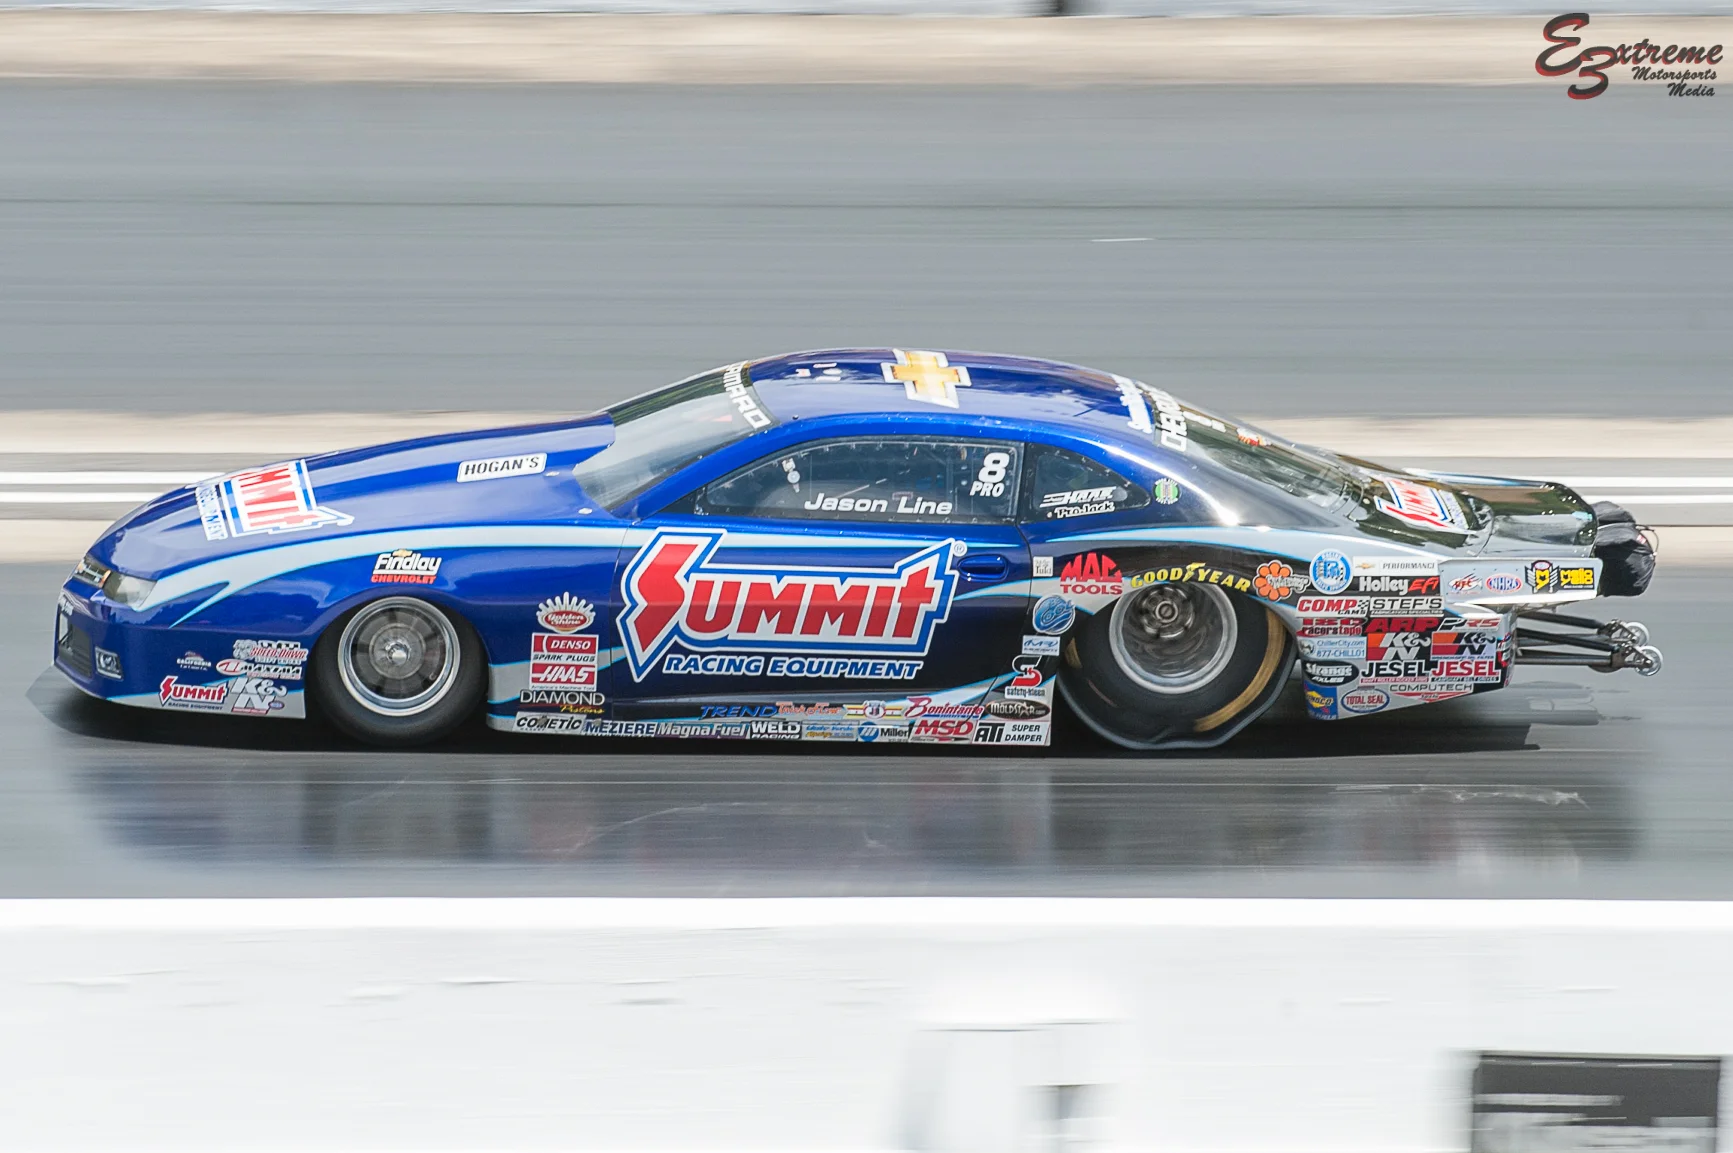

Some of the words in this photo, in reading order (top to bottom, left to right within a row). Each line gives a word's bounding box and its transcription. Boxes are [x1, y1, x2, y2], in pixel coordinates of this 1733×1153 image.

[464, 456, 540, 476] HOGAN'S
[978, 452, 1010, 483] 8
[969, 481, 1005, 497] PRO
[804, 493, 888, 513] Jason
[897, 496, 953, 515] Line
[373, 553, 442, 575] Findlay
[1060, 552, 1122, 582] MAC
[1382, 562, 1435, 570] PERFORMANCE
[371, 574, 436, 584] CHEVROLET
[1359, 576, 1409, 595] Holley
[1407, 576, 1440, 594] EFI
[1489, 578, 1517, 590] NHRA
[1060, 584, 1123, 595] TOOLS
[1298, 599, 1358, 612] COMP
[1372, 598, 1443, 610] STEF'S
[1365, 617, 1440, 633] ARP
[550, 640, 591, 650] DENSO
[532, 665, 595, 683] HAAS
[664, 656, 761, 675] RACING
[767, 658, 922, 679] EQUIPMENT
[1306, 663, 1353, 676] Strange
[1361, 662, 1428, 677] JESEL
[1432, 661, 1499, 676] JESEL
[1006, 687, 1046, 697] safety-kleen
[1390, 684, 1472, 692] COMPUTECH
[520, 691, 605, 706] DIAMOND
[1346, 696, 1366, 705] TOTAL
[1367, 696, 1384, 704] SEAL
[560, 704, 604, 714] Pistons
[701, 705, 778, 718] TREND
[586, 721, 654, 734] MEZIERE
[658, 723, 746, 738] MagnaFuel
[752, 721, 800, 733] WELD
[880, 727, 908, 738] Miller
[915, 720, 974, 736] MSD
[1005, 734, 1042, 742] DAMPER
